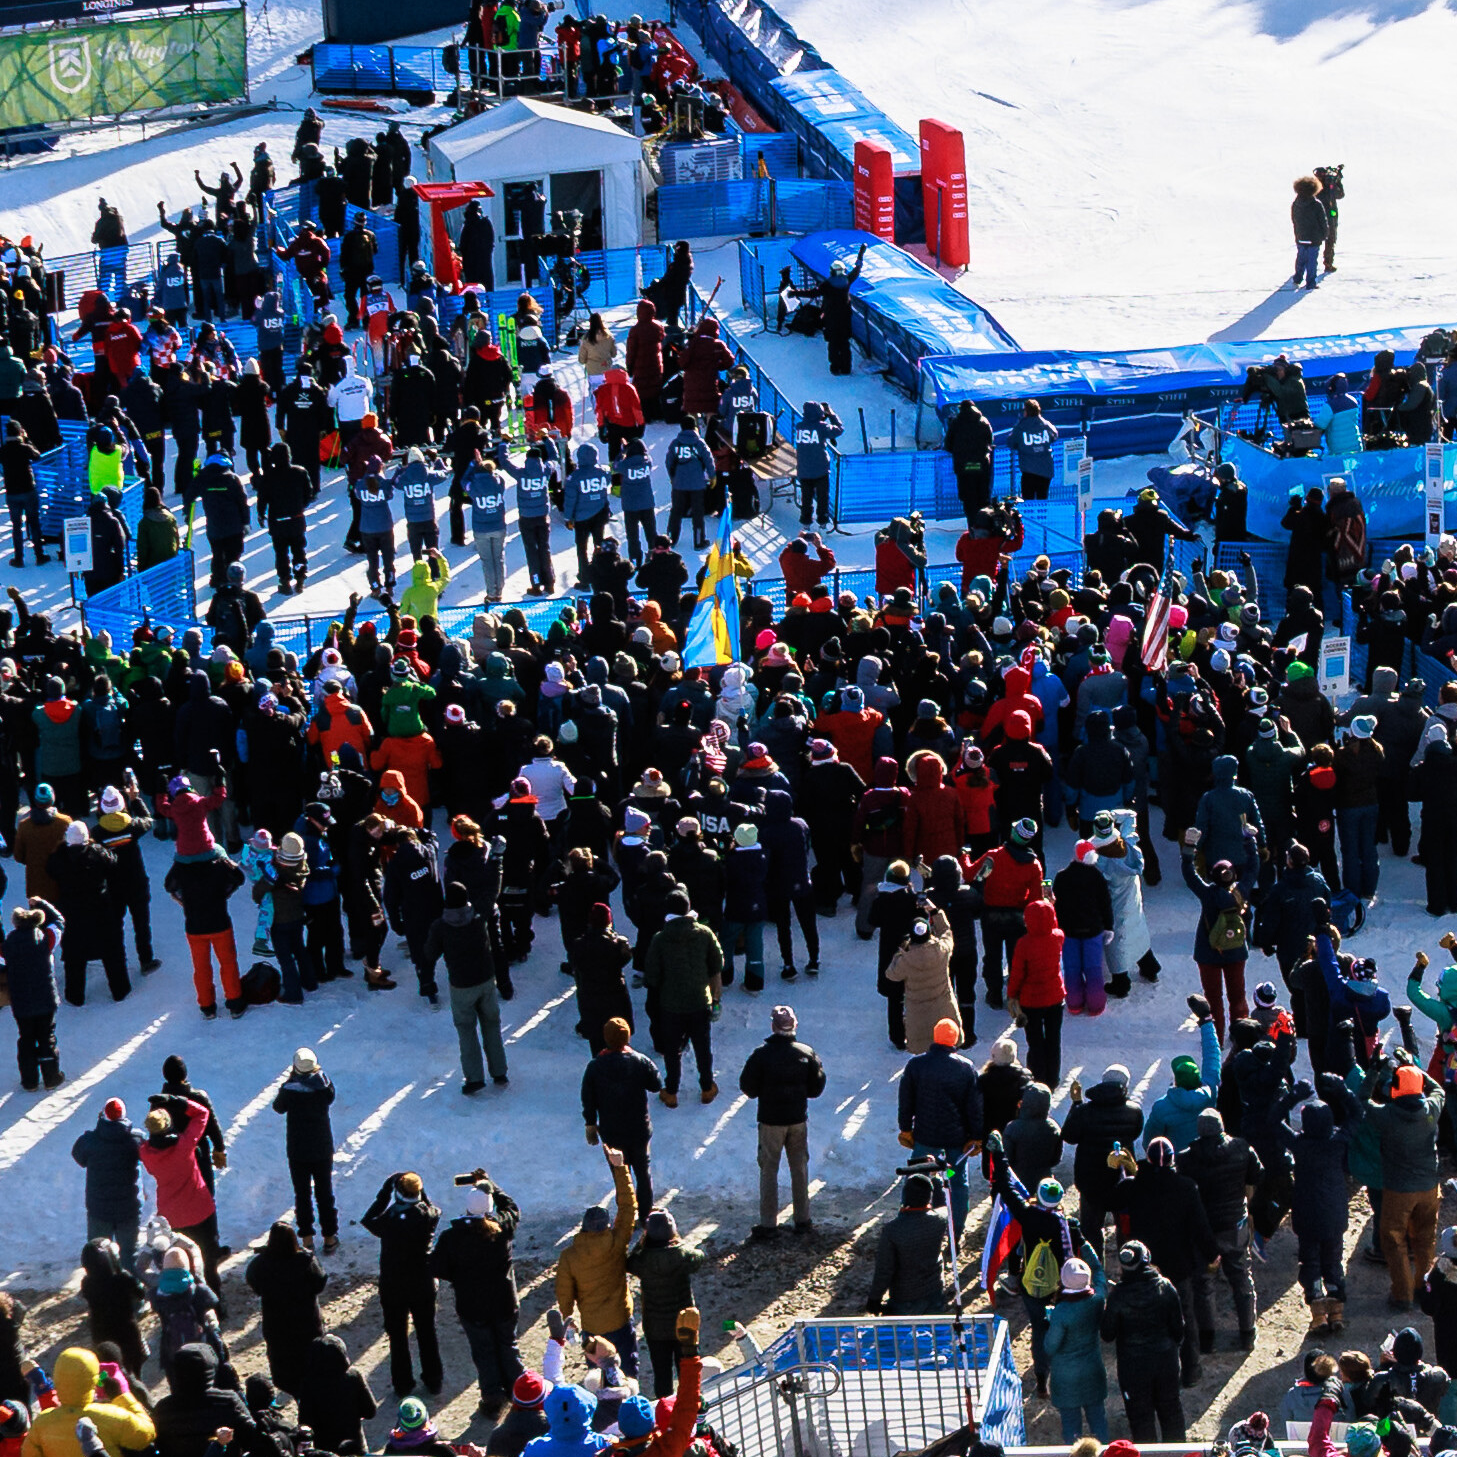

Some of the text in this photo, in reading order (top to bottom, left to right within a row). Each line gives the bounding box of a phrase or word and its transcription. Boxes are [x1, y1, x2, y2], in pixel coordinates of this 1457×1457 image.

[167, 277, 185, 288] USA
[265, 318, 284, 330] USA
[733, 396, 755, 409] USA
[1054, 397, 1085, 408] STIFEL
[796, 430, 819, 445] USA
[1024, 431, 1049, 447] USA
[628, 466, 651, 480] USA
[404, 483, 432, 499] USA
[521, 477, 549, 492] USA
[580, 479, 609, 494] USA
[361, 490, 385, 503] USA
[476, 494, 504, 509] USA
[411, 867, 430, 880] GBR
